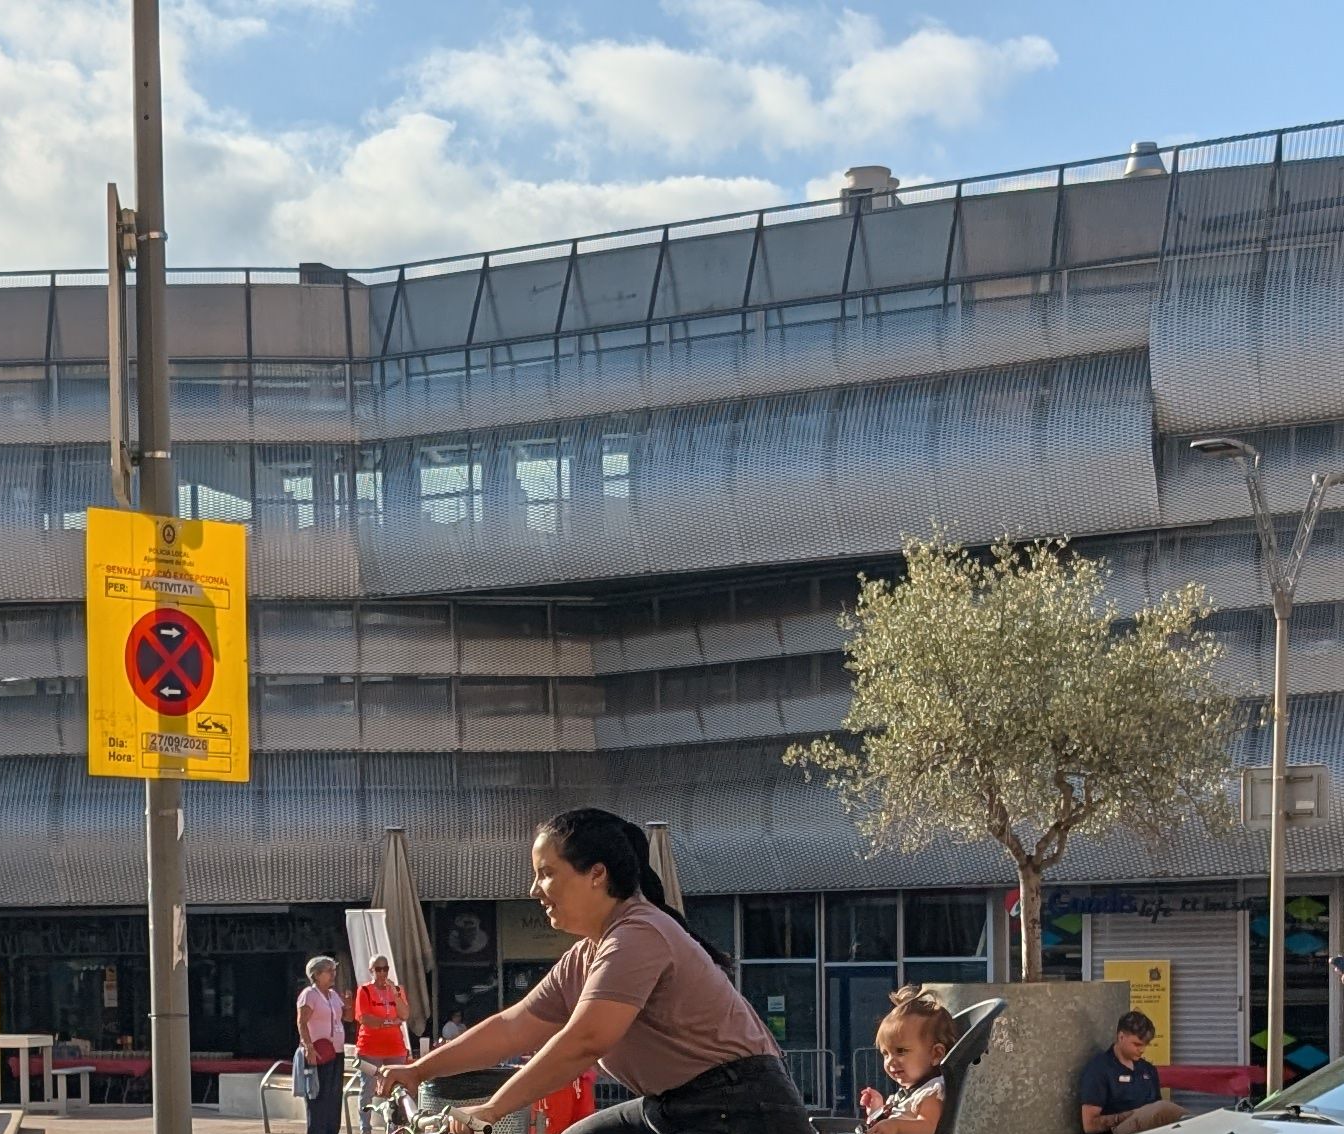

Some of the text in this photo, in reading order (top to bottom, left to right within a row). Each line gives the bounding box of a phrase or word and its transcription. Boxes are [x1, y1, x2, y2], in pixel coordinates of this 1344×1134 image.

[105, 564, 229, 586] SENYALITZACIÓ EXCEPCIONAL
[108, 581, 194, 595] PER: ACTIVITAT
[150, 734, 208, 751] 27/09/2026
[108, 752, 135, 762] Hora:
